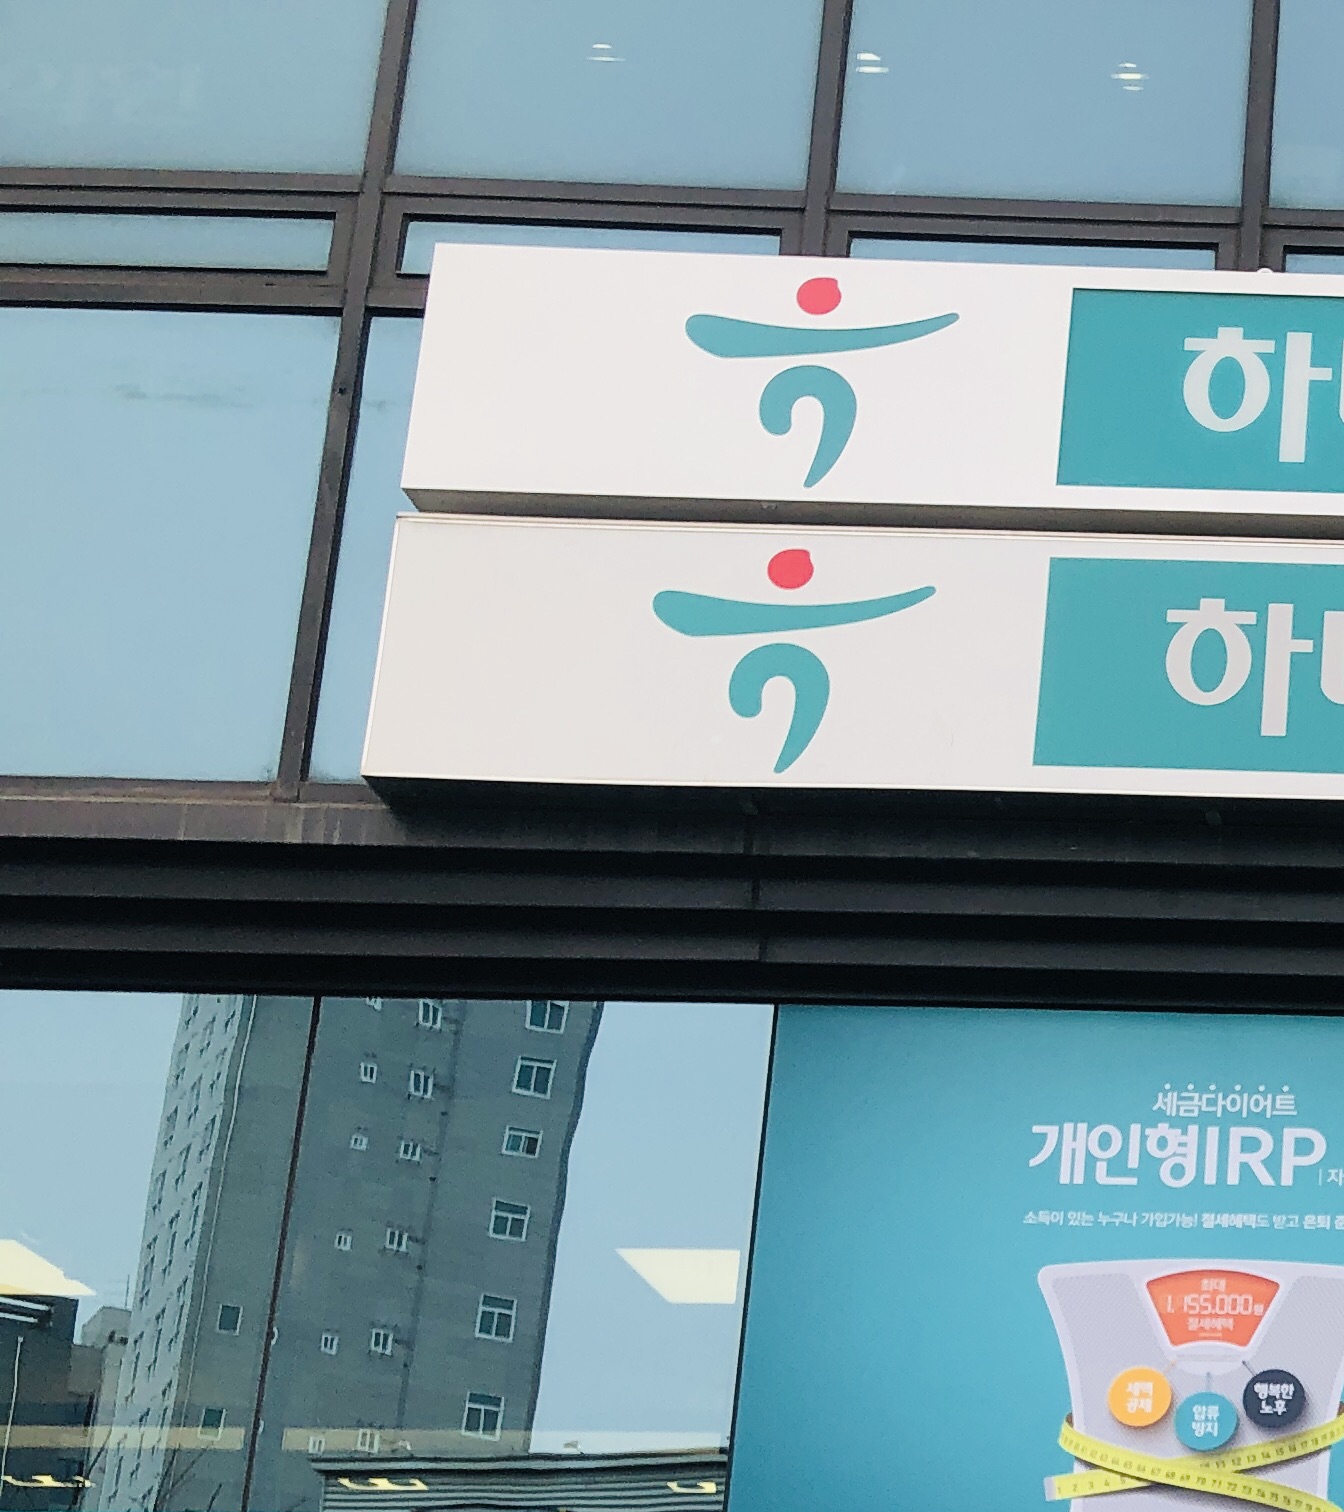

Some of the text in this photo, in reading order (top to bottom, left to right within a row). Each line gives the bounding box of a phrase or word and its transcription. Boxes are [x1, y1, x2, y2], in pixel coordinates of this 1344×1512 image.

[1152, 1088, 1297, 1118] 세금다이어트
[1028, 1122, 1327, 1188] 개인형IRP
[1068, 1211, 1094, 1226] 있는
[1098, 1211, 1137, 1227] 누구나
[1273, 1214, 1299, 1229] 받고
